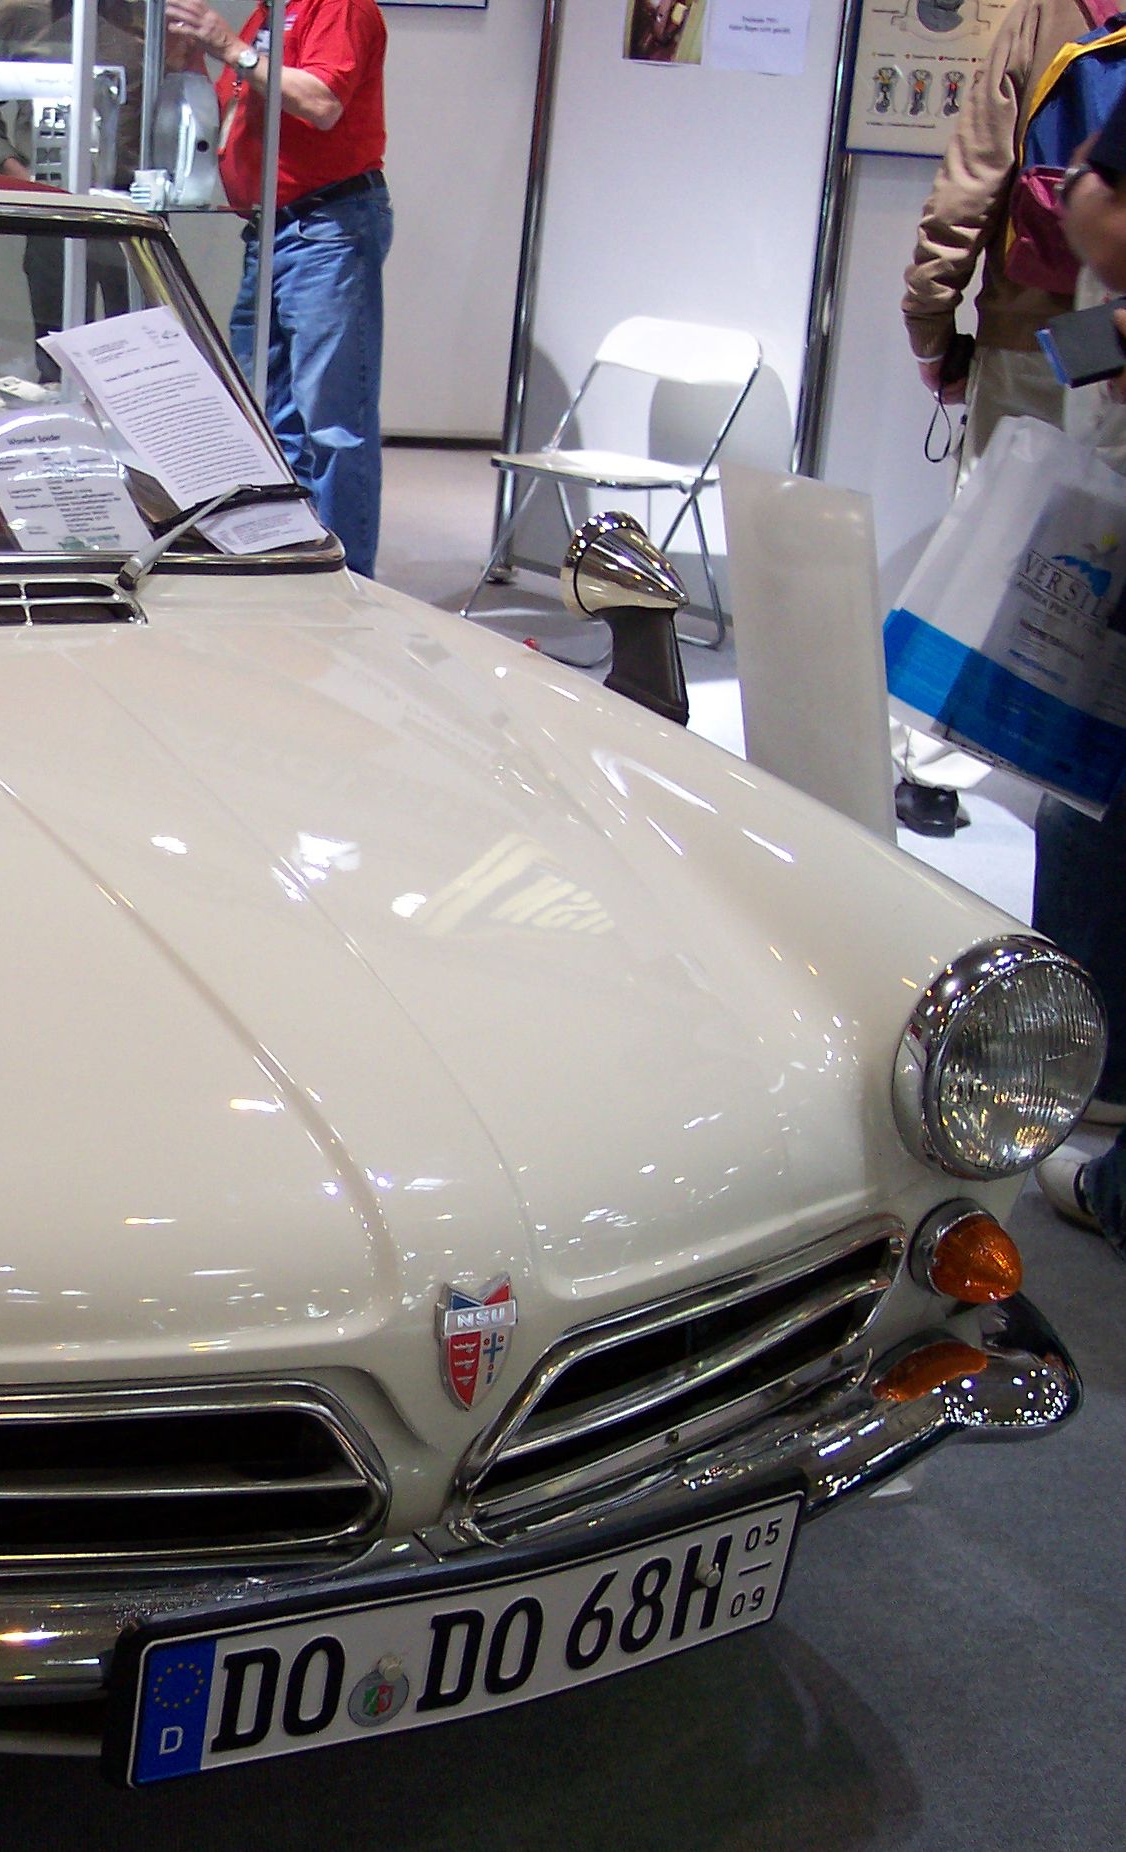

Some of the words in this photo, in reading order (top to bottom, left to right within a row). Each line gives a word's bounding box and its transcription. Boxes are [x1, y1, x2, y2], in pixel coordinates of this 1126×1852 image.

[457, 1307, 505, 1328] NSU
[745, 1517, 782, 1552] 05
[729, 1586, 765, 1618] 09
[211, 1636, 345, 1753] DO
[416, 1597, 544, 1712] DO
[565, 1533, 732, 1671] 68H
[159, 1726, 183, 1755] D
